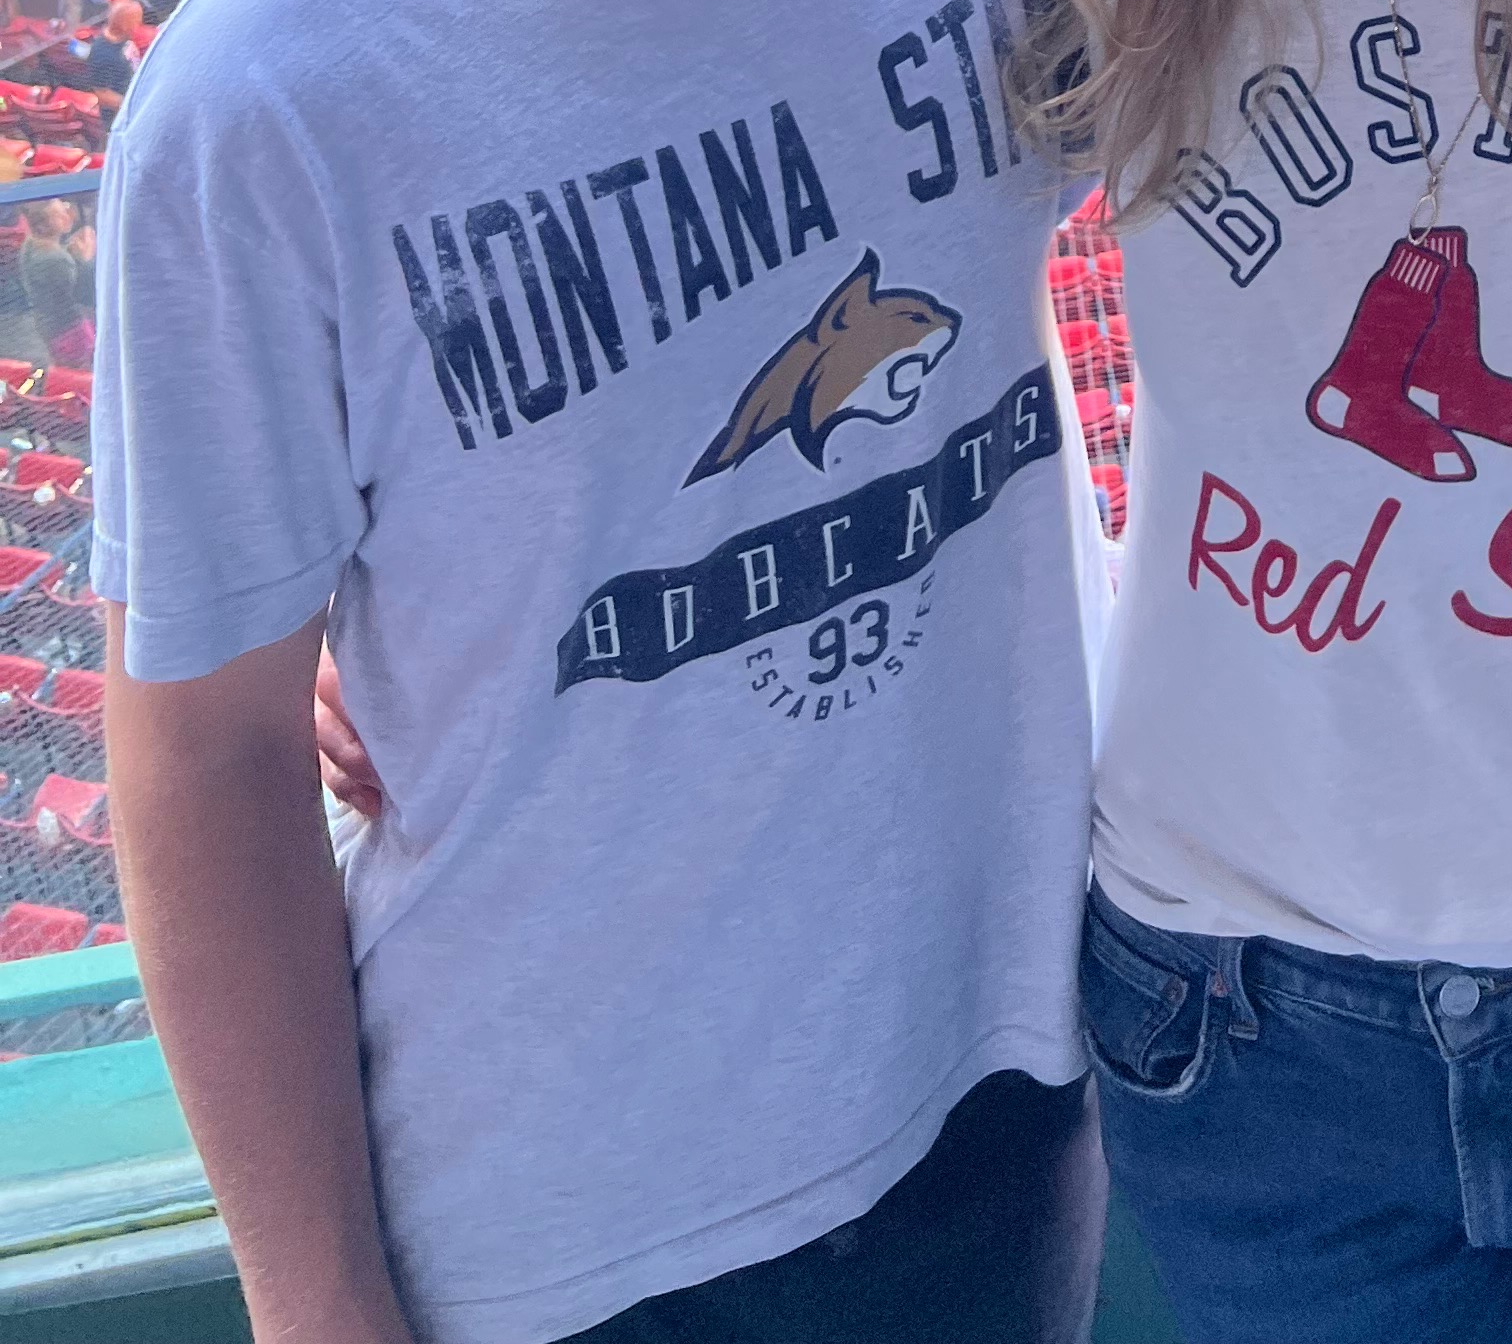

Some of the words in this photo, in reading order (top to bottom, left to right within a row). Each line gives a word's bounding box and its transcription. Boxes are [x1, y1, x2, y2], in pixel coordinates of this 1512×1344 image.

[391, 100, 840, 452] MONTANA
[583, 385, 1040, 663] BOBCATS
[1188, 471, 1402, 652] Red
[808, 600, 891, 686] 93
